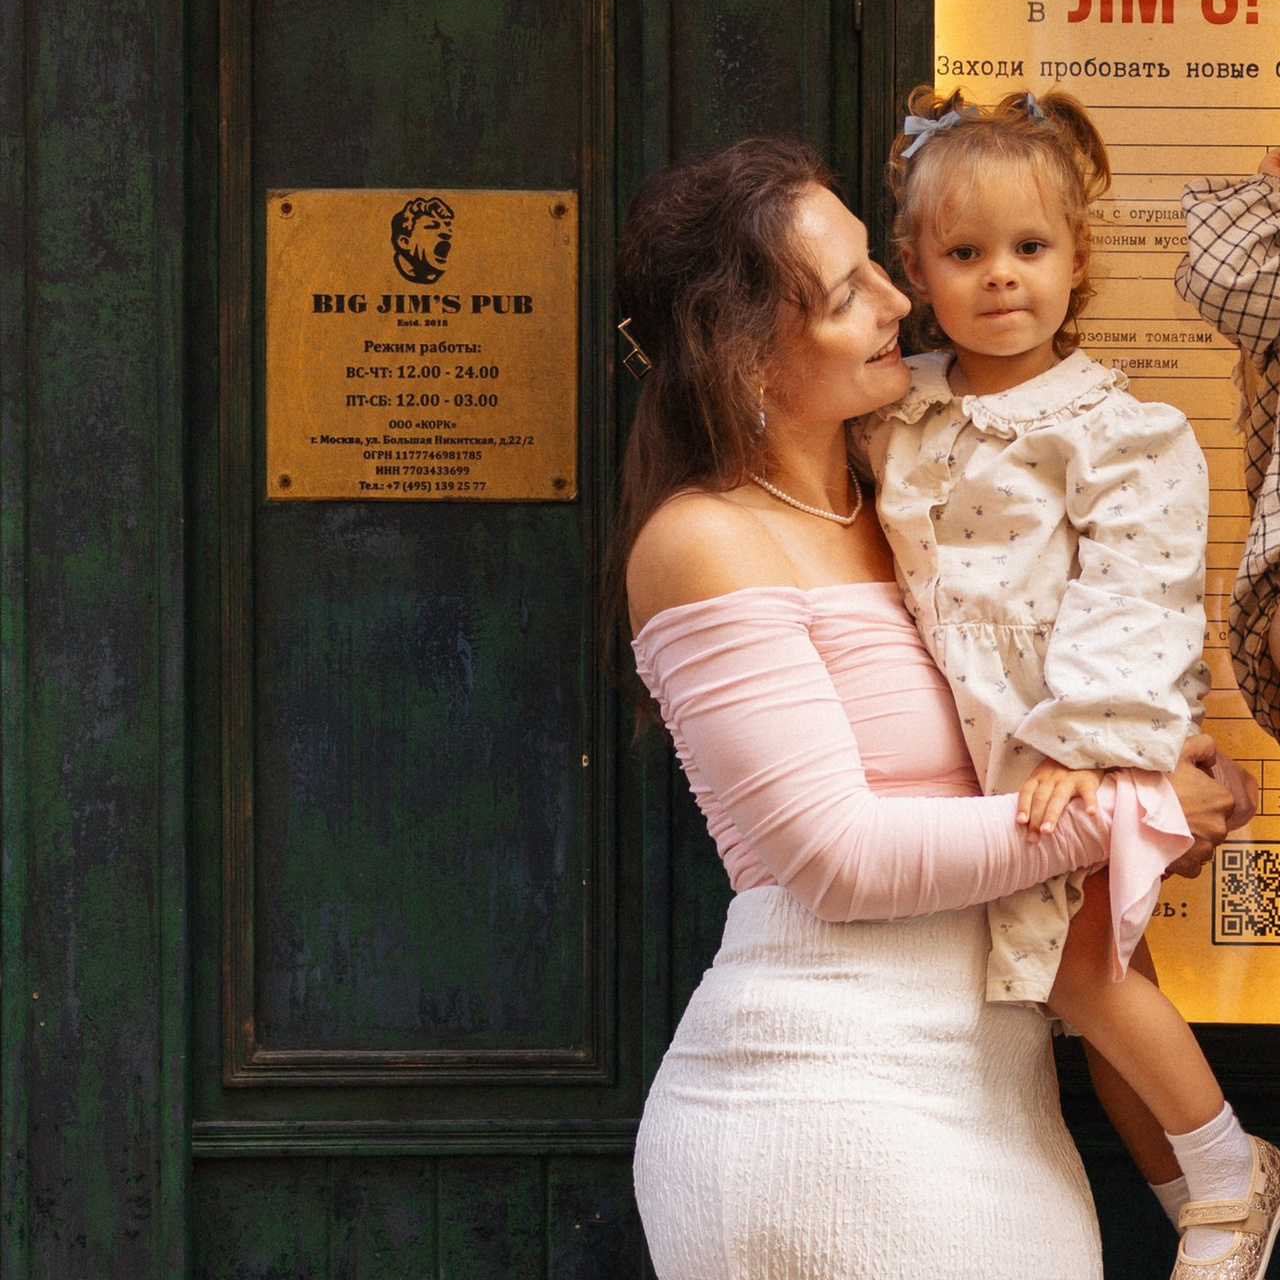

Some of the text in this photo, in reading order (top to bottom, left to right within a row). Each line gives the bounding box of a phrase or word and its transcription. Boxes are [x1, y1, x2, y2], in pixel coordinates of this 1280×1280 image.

[936, 55, 1025, 79] Заходи
[1040, 56, 1171, 83] пробовать
[1186, 62, 1260, 79] новые
[311, 293, 534, 315] BIG JIM'S PUB
[396, 318, 449, 327] Estd. 2018
[1145, 332, 1213, 344] томатами
[363, 339, 482, 357] Режим работы:
[345, 366, 393, 379] ВС-ЧТ:
[396, 364, 442, 379] 12.00
[454, 365, 500, 380] 24.00
[1111, 357, 1180, 373] гренками
[345, 394, 392, 408] ПТ-СБ:
[395, 392, 441, 408] 12.00
[453, 393, 499, 408] 03.00
[388, 419, 413, 430] ООО
[310, 434, 535, 448] г. Москва, ул. Большая Никитская, д.22/2
[362, 450, 483, 461] ОГРН 1177746981785
[375, 465, 471, 476] ИНН 7703433699
[358, 480, 487, 494] Тел.: +7 (495) 139 25 77
